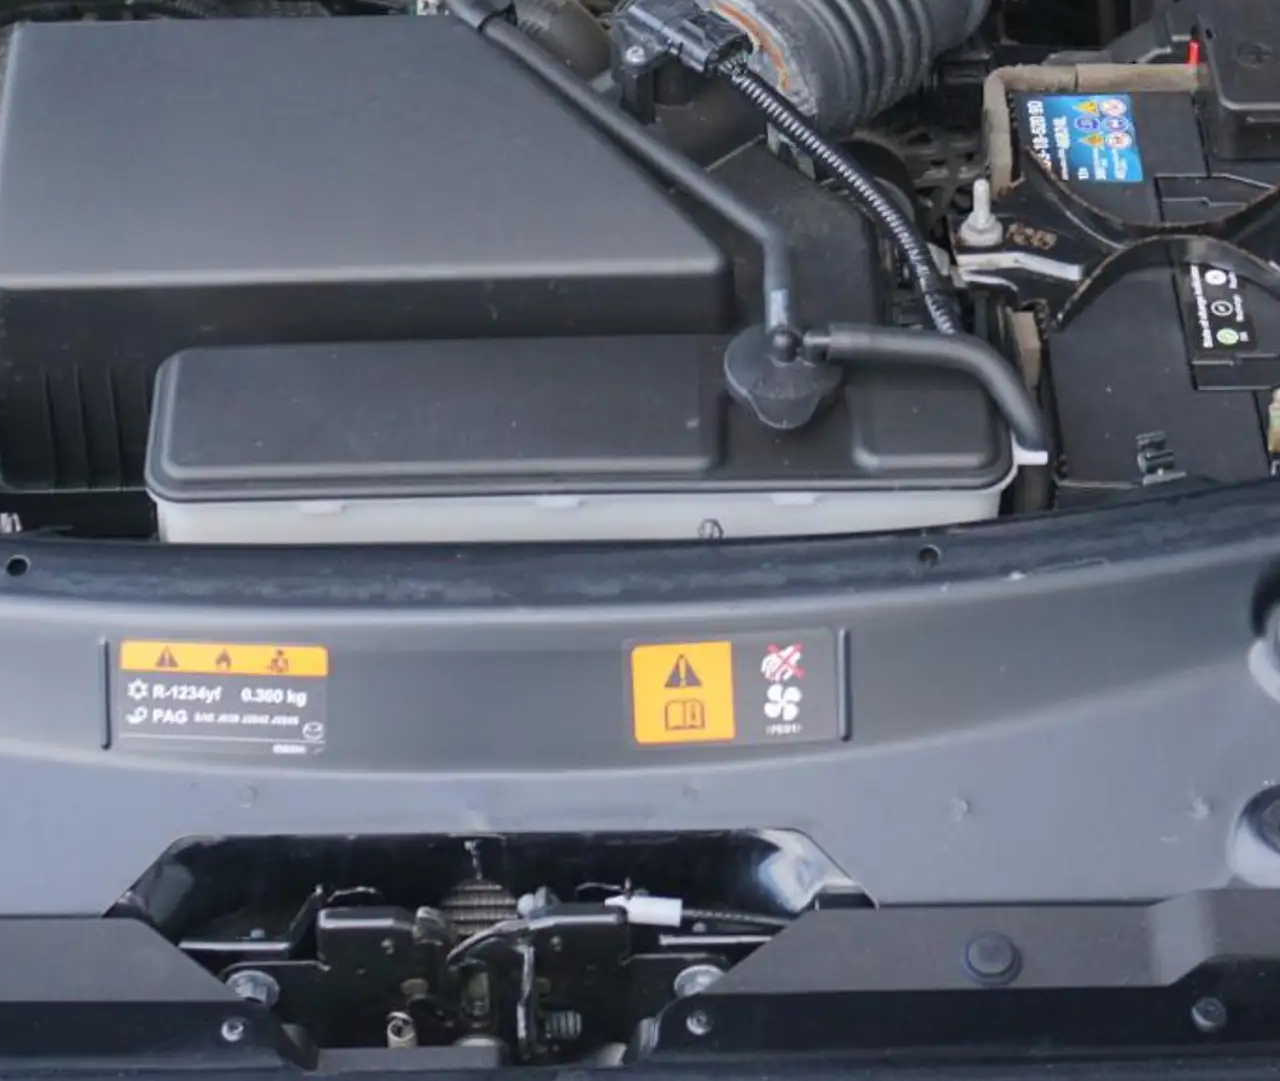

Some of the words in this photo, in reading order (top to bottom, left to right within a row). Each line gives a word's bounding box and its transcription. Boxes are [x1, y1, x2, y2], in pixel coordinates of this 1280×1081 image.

[152, 684, 223, 704] R-1234yf
[286, 689, 308, 707] kg
[152, 708, 189, 724] PAG
